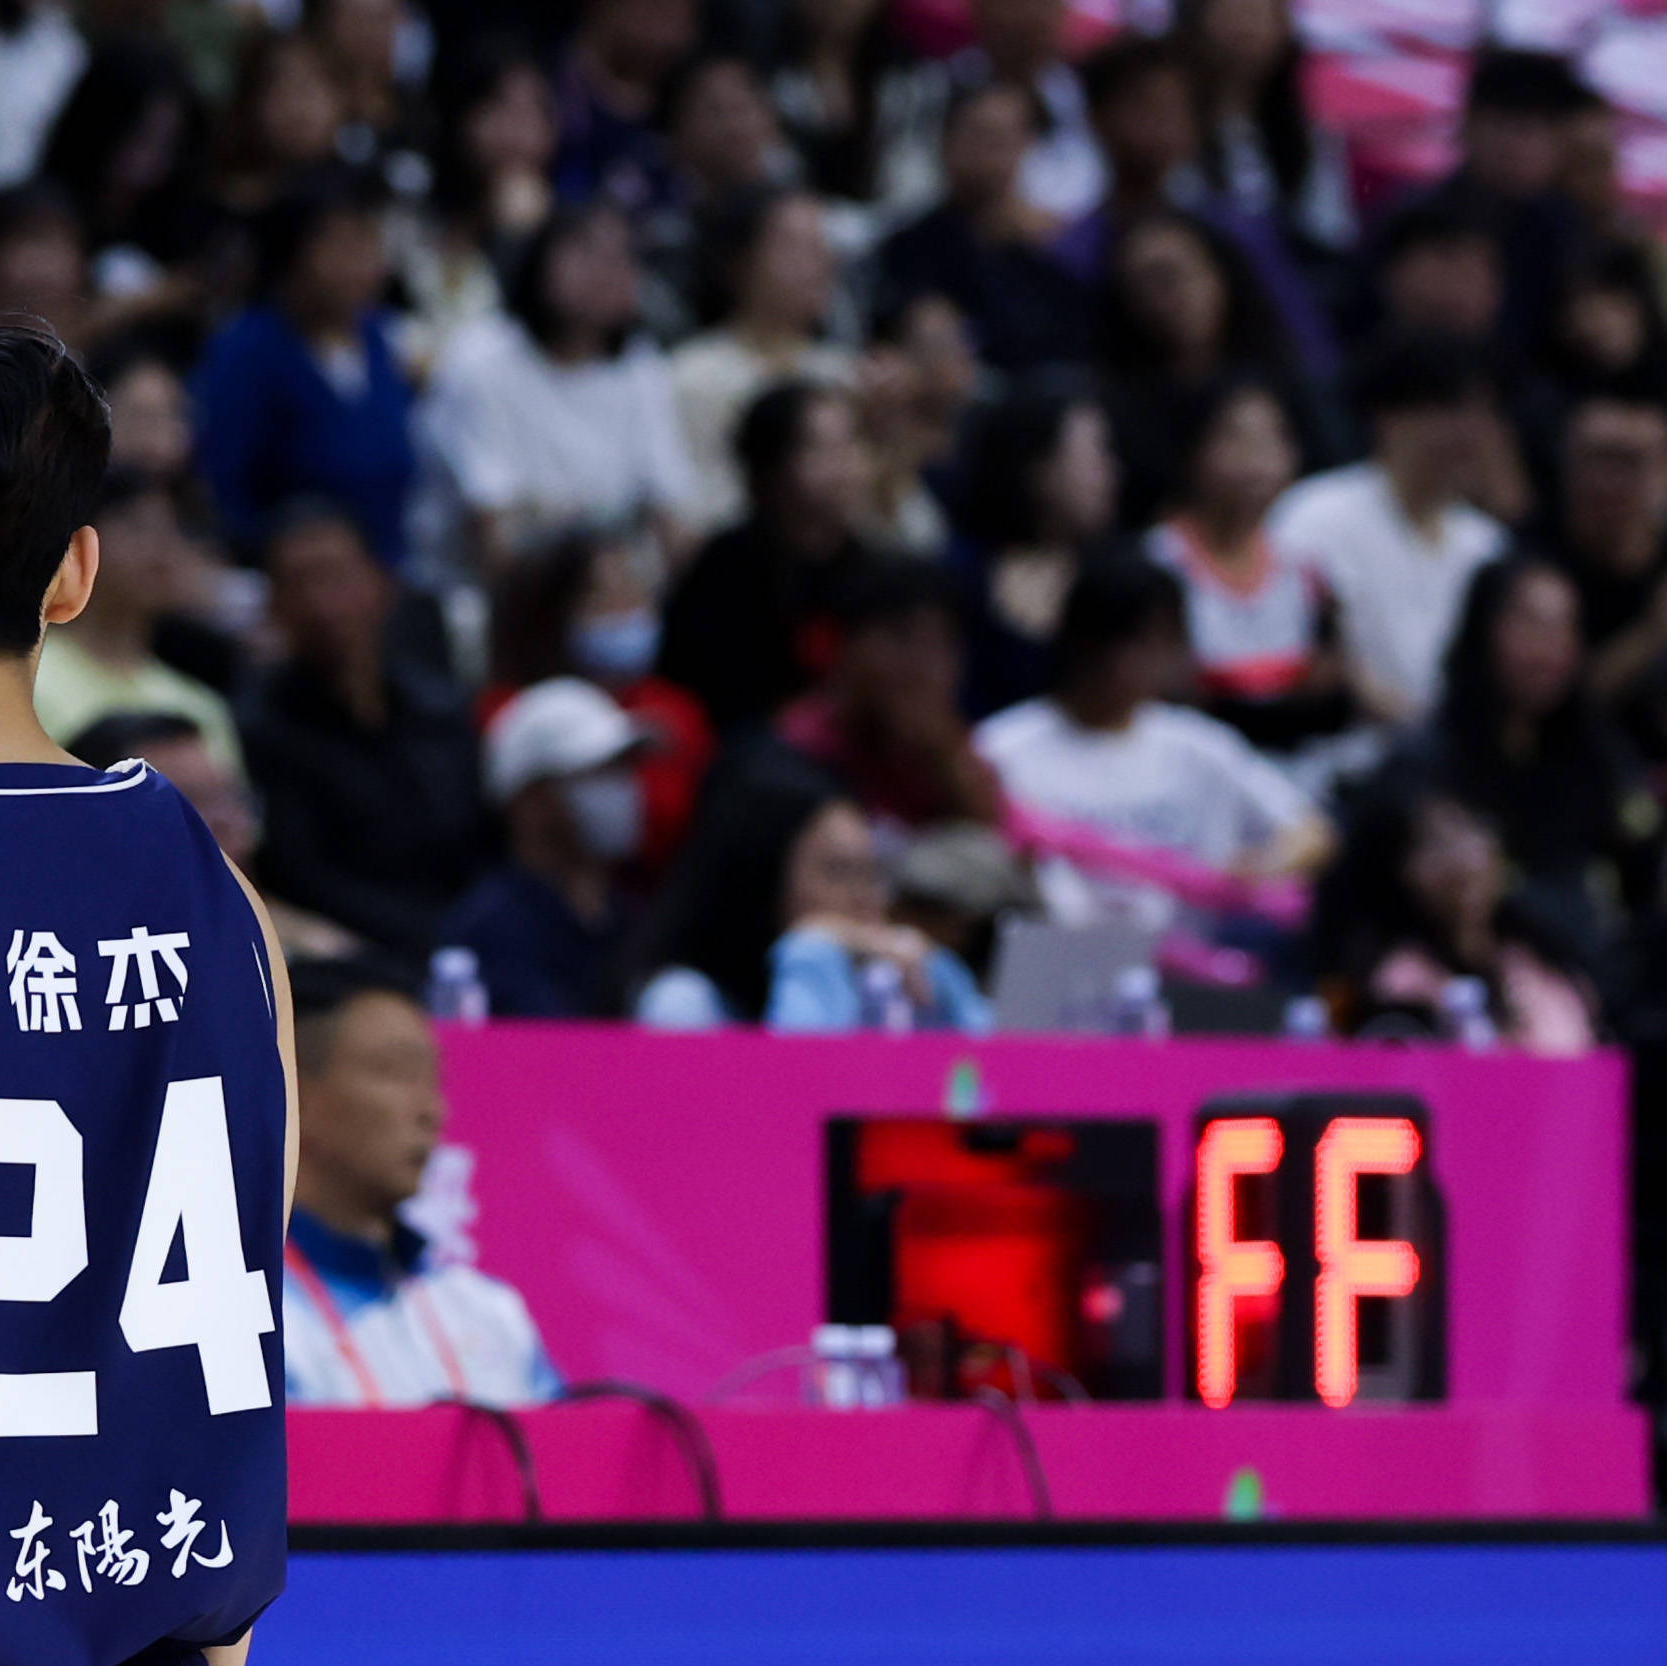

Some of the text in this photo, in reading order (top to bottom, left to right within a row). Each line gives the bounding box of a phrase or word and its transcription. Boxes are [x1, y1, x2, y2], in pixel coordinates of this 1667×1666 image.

[6, 926, 190, 1032] 徐杰
[1196, 1116, 1421, 1408] FF
[6, 1489, 234, 1602] 东陽光
